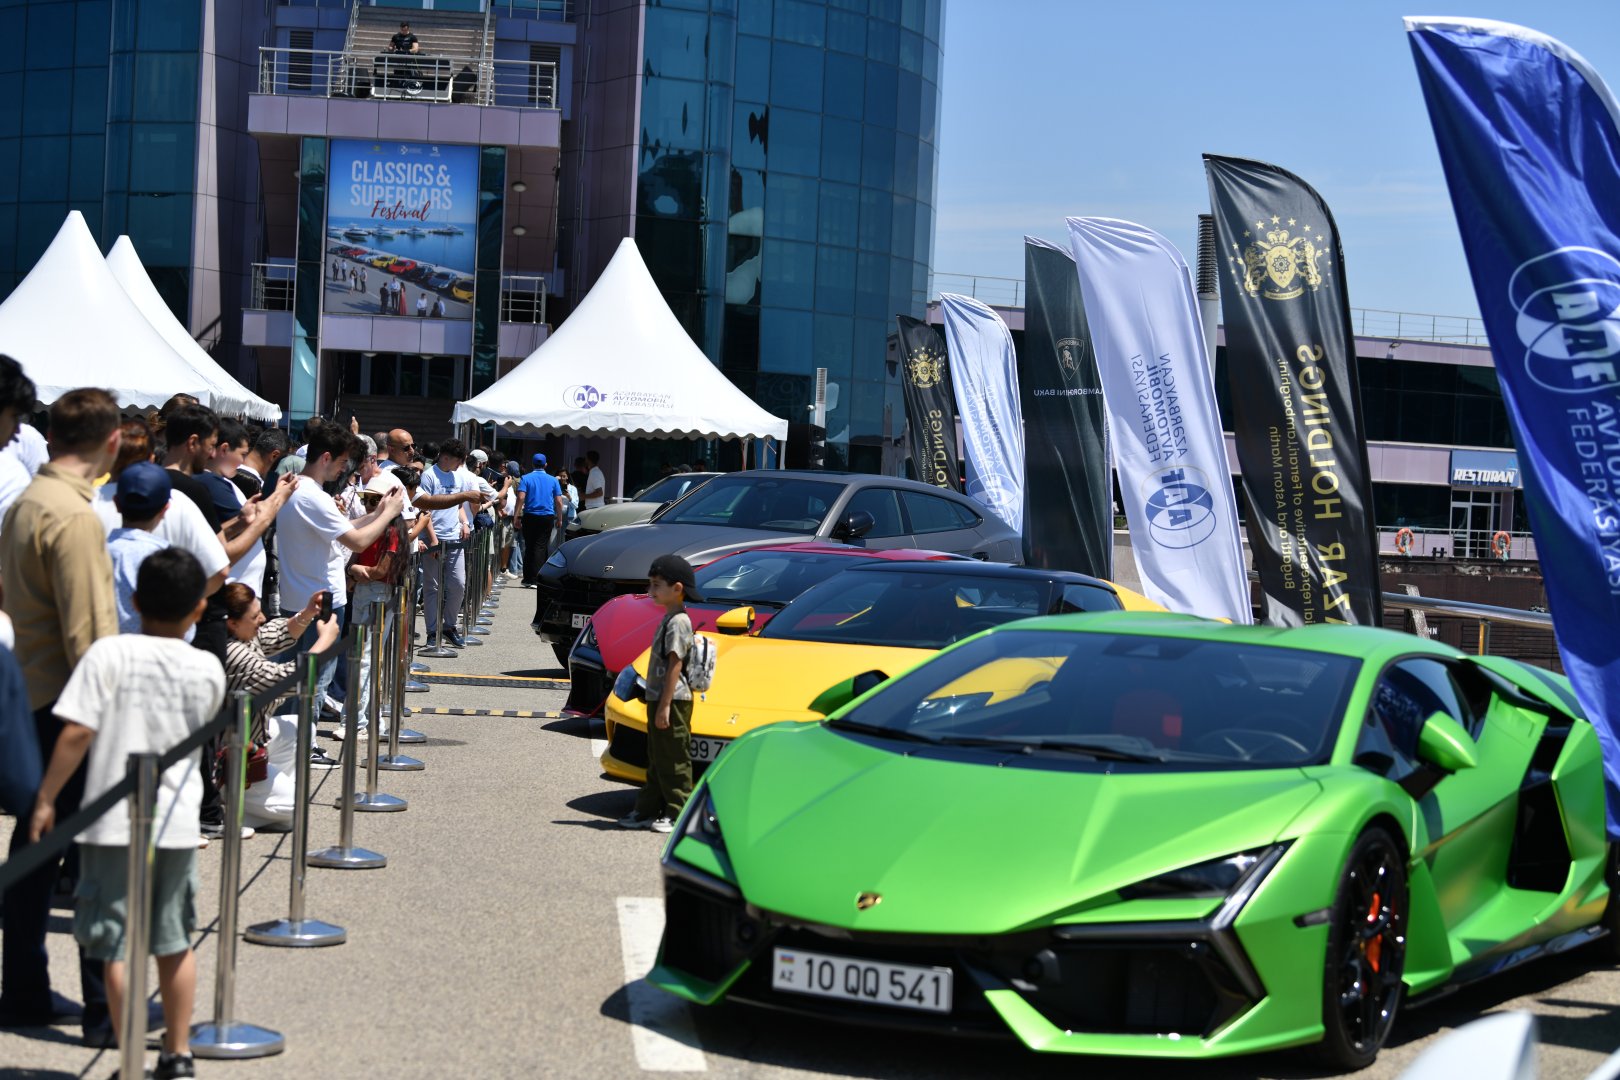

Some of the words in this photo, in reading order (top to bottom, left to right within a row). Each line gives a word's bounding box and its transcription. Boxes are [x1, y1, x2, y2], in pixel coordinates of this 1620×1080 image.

[351, 159, 434, 186] CLASSICS
[436, 164, 451, 187] &
[350, 184, 453, 211] SUPERCARS
[370, 200, 432, 222] Festival
[1551, 291, 1617, 382] AAF
[576, 392, 608, 402] AAF
[806, 957, 835, 991] 10
[844, 964, 879, 998] QQ
[889, 970, 941, 1007] 541
